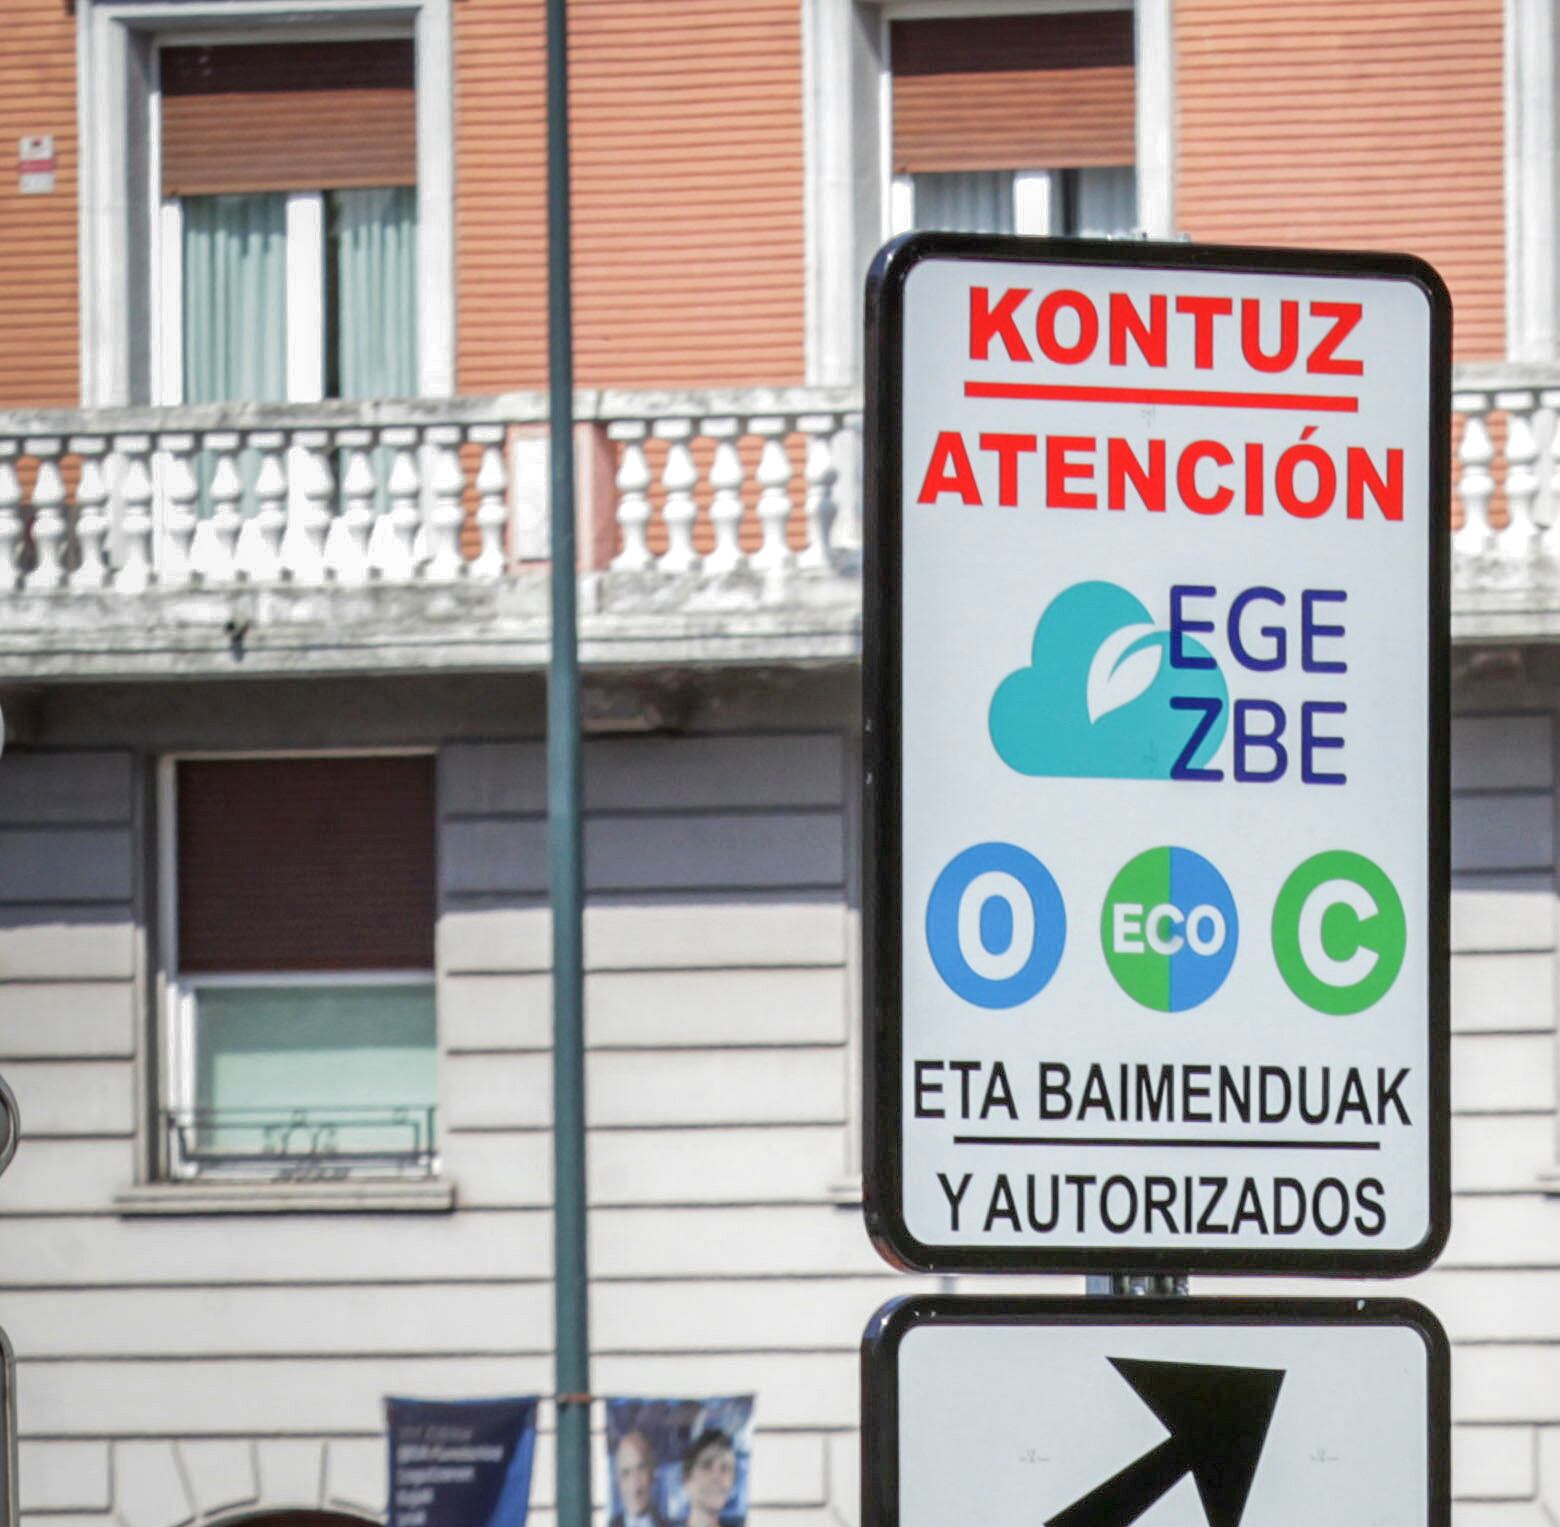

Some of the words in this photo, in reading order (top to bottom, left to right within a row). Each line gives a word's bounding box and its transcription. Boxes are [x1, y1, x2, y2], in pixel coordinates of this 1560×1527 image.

[968, 286, 1364, 376] KONTUZ
[916, 426, 1404, 522] ATENCIÓN
[1169, 584, 1349, 674] EGE
[1169, 697, 1348, 786] ZBE
[1112, 902, 1226, 957] ECO
[1297, 878, 1380, 988] C
[914, 1059, 1018, 1120] ETA
[1039, 1061, 1412, 1126] BAIMENDUAK
[935, 1172, 974, 1232] Y
[983, 1173, 1387, 1236] AUTORIZADOS
